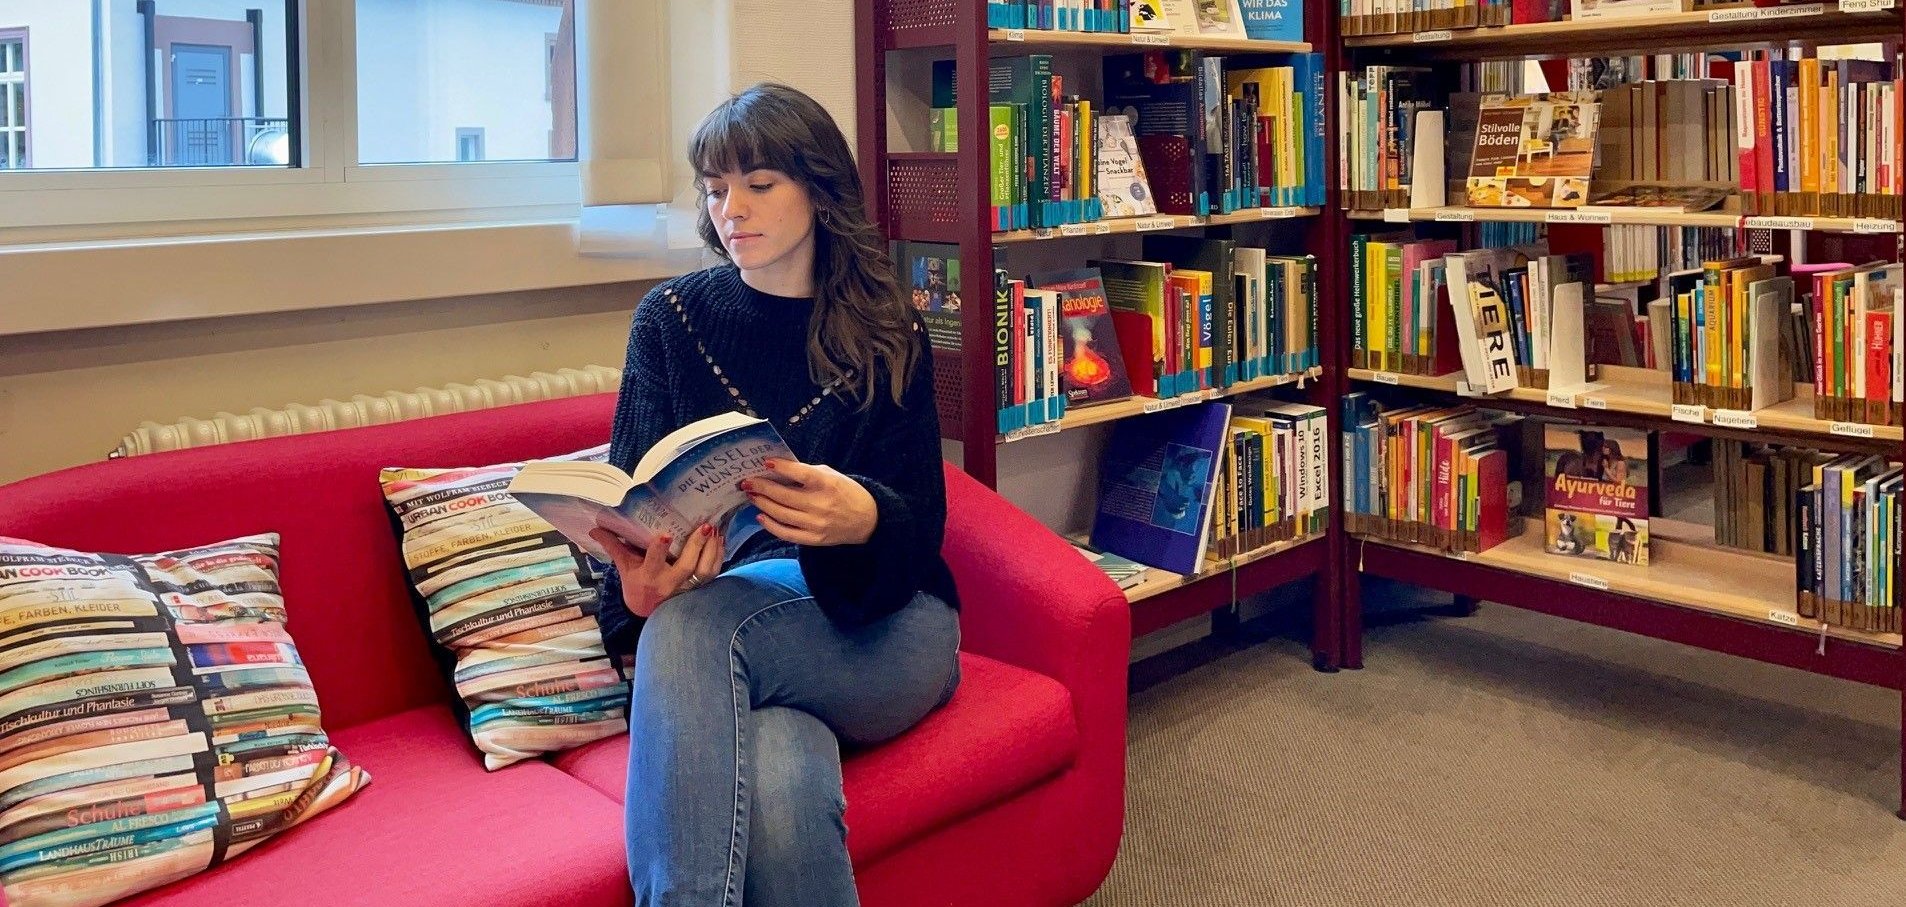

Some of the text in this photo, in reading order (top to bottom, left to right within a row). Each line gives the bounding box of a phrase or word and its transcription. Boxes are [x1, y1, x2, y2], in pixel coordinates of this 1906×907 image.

[1842, 0, 1868, 10] Feng
[1248, 11, 1283, 21] KLIMA
[1712, 4, 1823, 21] Gestaltung Kinderzimmer
[1008, 31, 1024, 39] Klima
[1414, 31, 1451, 41] Gestaltung
[1041, 79, 1049, 123] BIOLOGIE
[1480, 122, 1521, 134] Stilvolle
[1478, 133, 1519, 146] Böden
[1042, 148, 1051, 195] PFLANZEN
[1436, 212, 1473, 222] Gestaltung
[1548, 213, 1566, 221] Haus
[1745, 219, 1811, 229] ebäudeausbau
[1855, 221, 1895, 232] Heizung
[1352, 240, 1361, 297] Heimwerkerbuch
[1709, 289, 1717, 332] AQUARIUM
[1202, 298, 1212, 342] Vögel
[996, 289, 1009, 367] BIONIK
[1354, 337, 1362, 350] Das
[1672, 406, 1700, 417] Fische
[1714, 414, 1756, 426] Nagetiere
[1298, 430, 1305, 442] 10
[1831, 423, 1872, 437] Geflügel
[678, 475, 696, 493] DIE
[694, 447, 751, 478] INSEL
[749, 444, 774, 455] DER
[1313, 427, 1322, 500] Excel 2016
[1555, 472, 1636, 499] Ayurveda
[406, 497, 424, 509] MIT
[407, 491, 514, 524] URBAN COOK BOO
[1599, 495, 1636, 509] für Tiere
[450, 532, 492, 549] FARBEN,
[493, 524, 532, 538] KLEIDER
[19, 567, 65, 578] COOK
[17, 602, 122, 622] FARBEN, KLEIDER
[496, 609, 514, 622] und
[514, 599, 555, 617] Phantasie
[1770, 611, 1797, 624] Katze
[0, 697, 136, 733] Tischkultur und Phantasie
